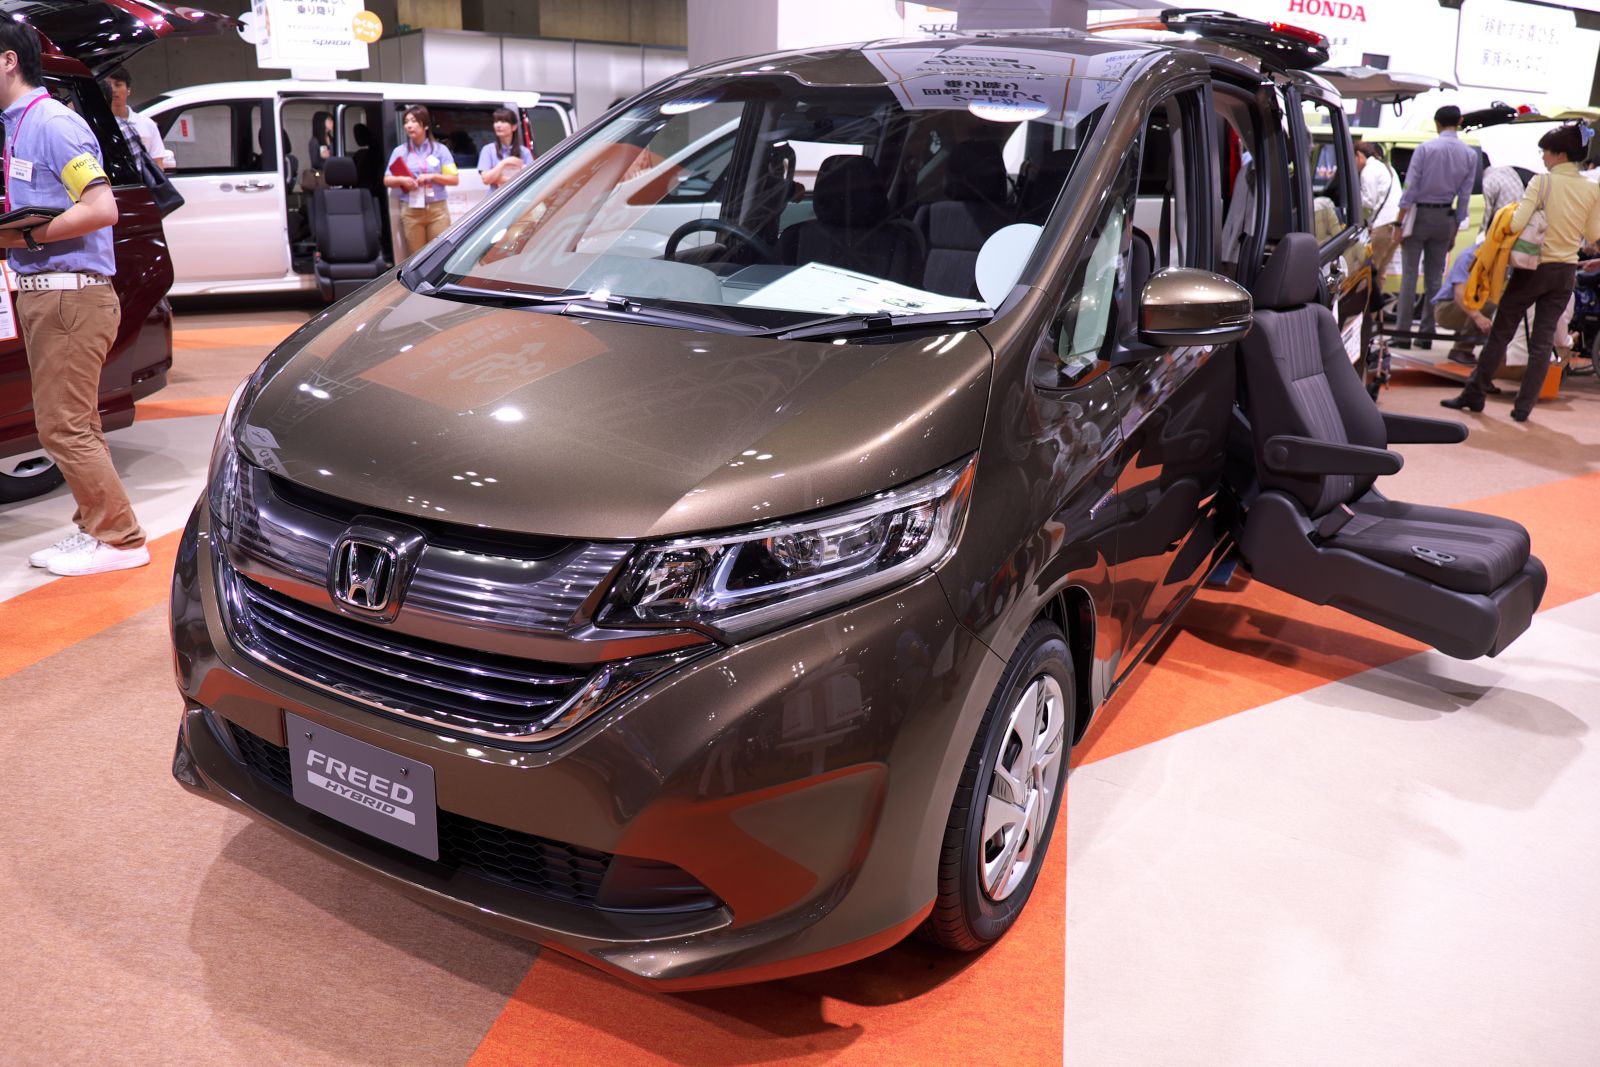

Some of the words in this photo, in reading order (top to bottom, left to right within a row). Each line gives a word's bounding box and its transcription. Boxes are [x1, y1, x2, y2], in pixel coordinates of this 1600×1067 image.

[1288, 0, 1366, 21] HONDA
[306, 749, 414, 805] FREED
[325, 780, 396, 815] HYBRID
